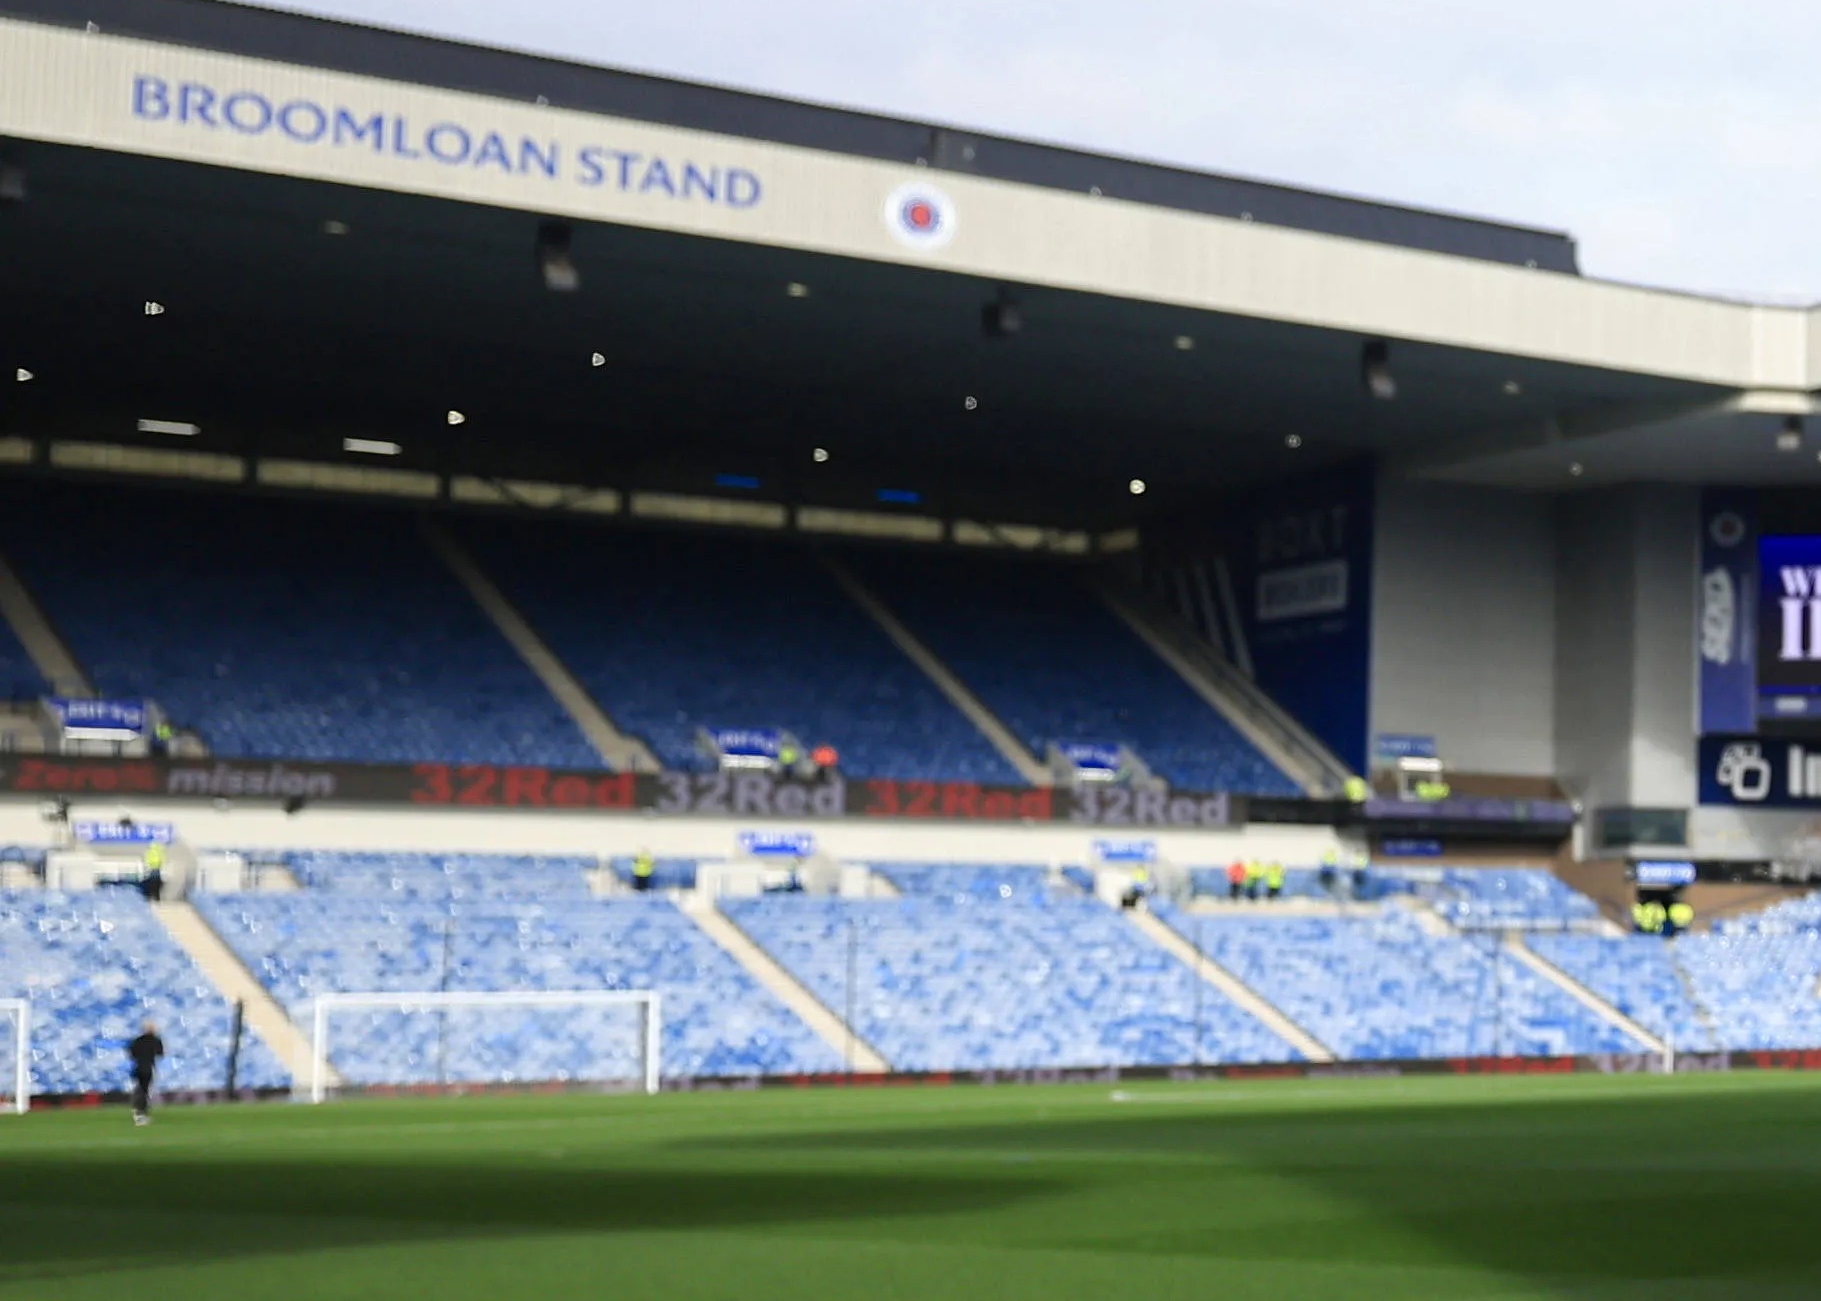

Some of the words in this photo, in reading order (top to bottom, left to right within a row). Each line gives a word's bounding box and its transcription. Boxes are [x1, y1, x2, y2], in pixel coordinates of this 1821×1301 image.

[131, 75, 557, 180] BROOMLOAN
[576, 147, 762, 210] STAND
[167, 760, 336, 798] mission
[410, 764, 636, 808] 32Red
[657, 771, 847, 816] 32Red
[866, 779, 1052, 820] 32Red
[1070, 785, 1228, 826] 32Red
